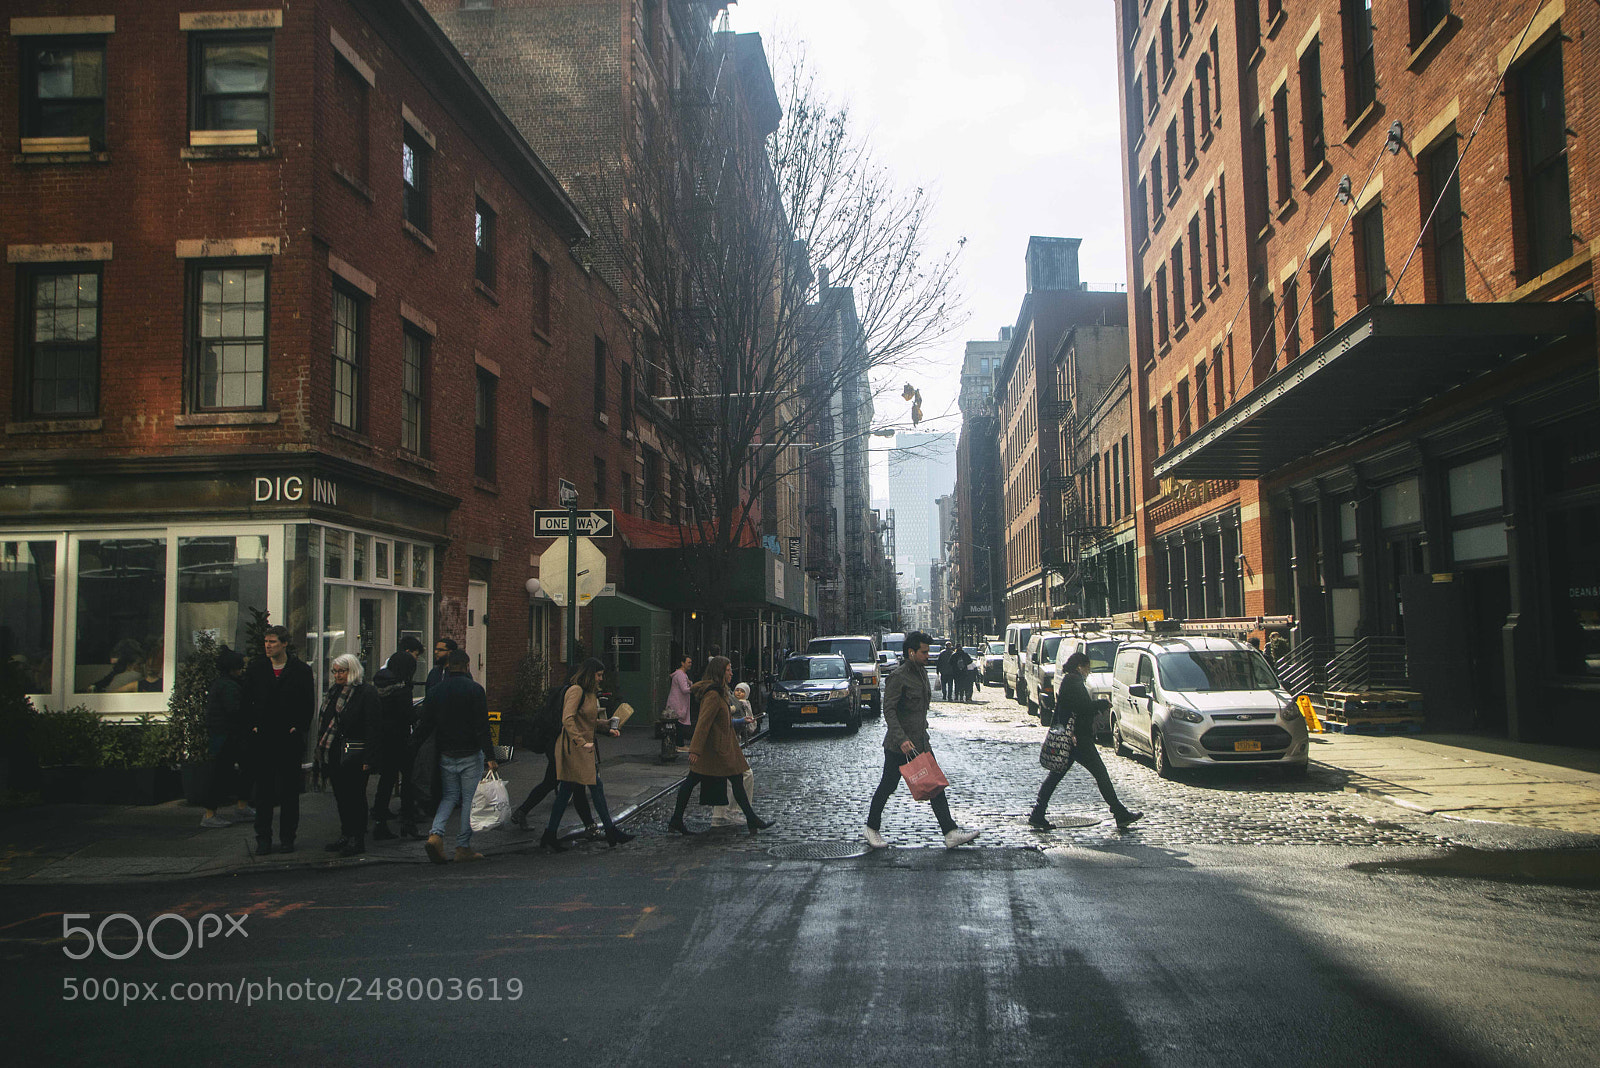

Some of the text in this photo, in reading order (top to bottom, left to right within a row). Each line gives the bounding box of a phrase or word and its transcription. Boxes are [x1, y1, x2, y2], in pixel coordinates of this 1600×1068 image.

[255, 476, 337, 506] DIG INN
[545, 518, 601, 529] ONE WAY
[970, 605, 992, 613] MoMA
